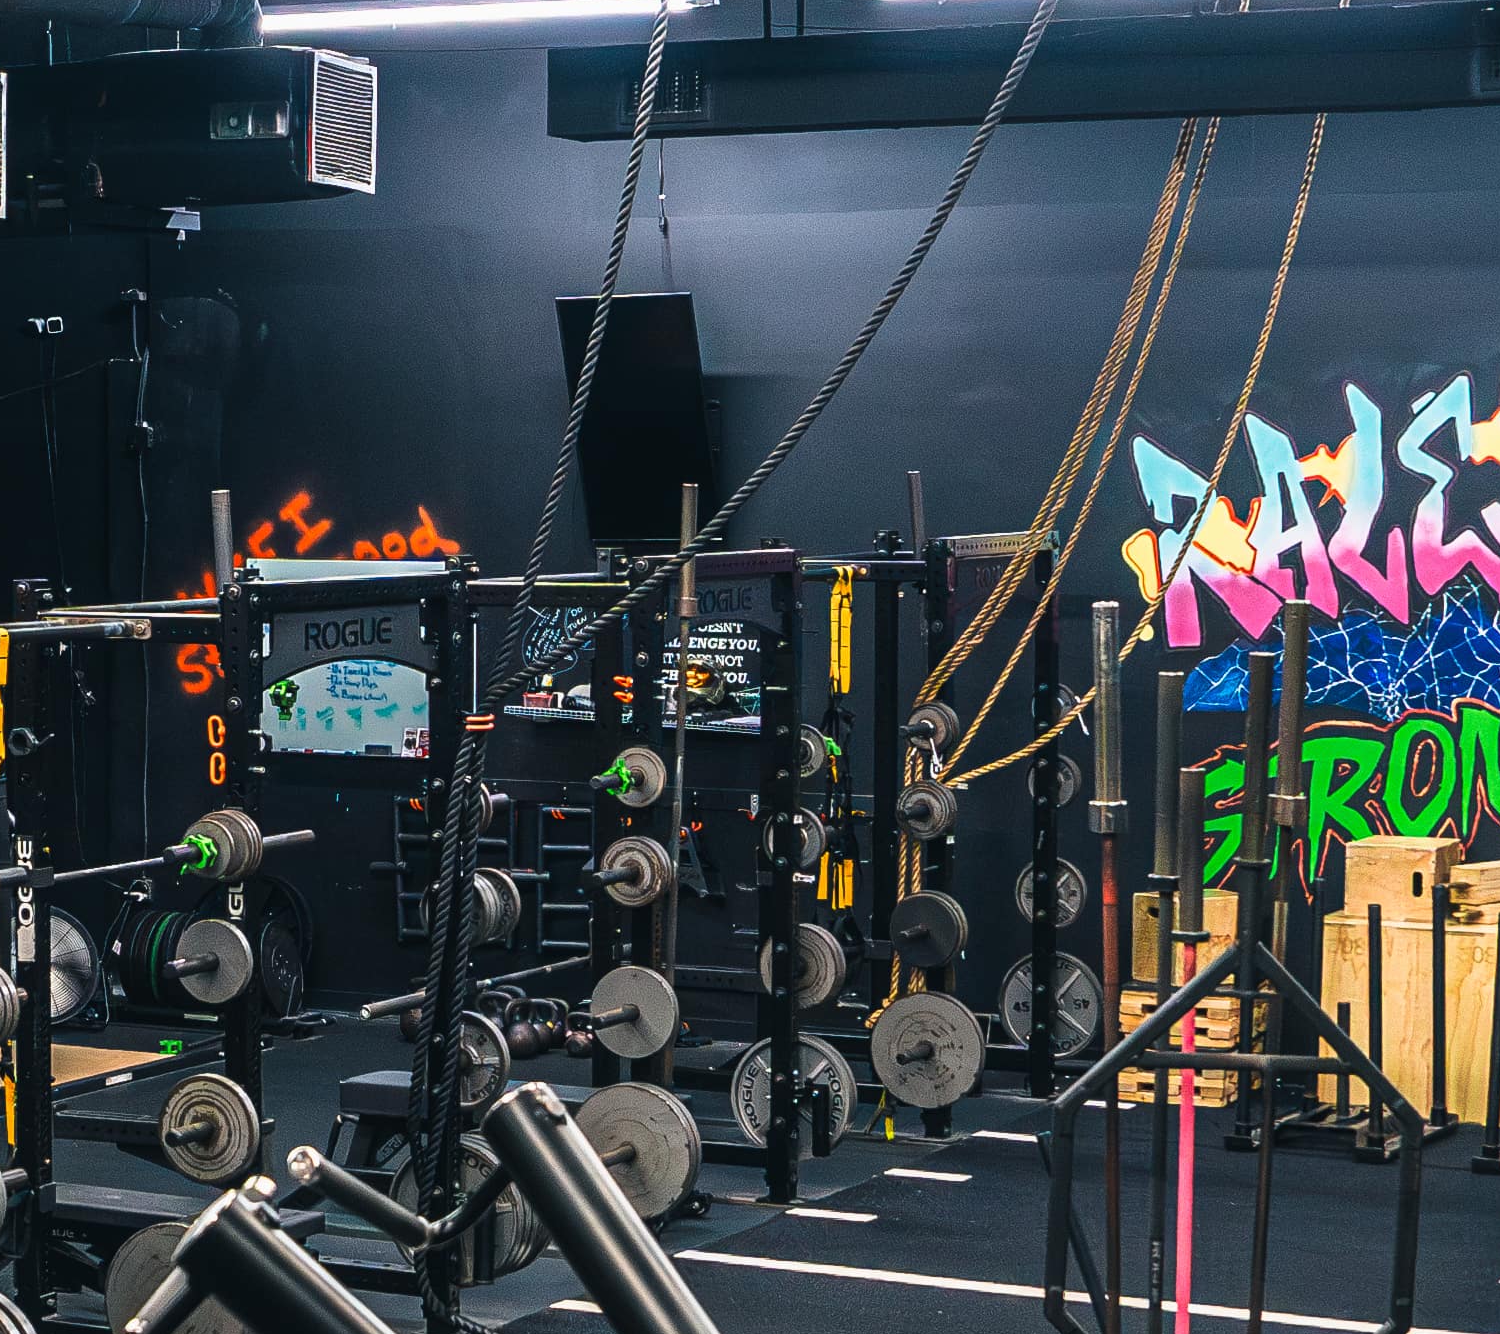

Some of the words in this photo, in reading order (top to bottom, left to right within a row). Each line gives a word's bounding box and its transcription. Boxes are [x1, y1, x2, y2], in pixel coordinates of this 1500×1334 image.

[304, 618, 393, 652] ROGUE
[714, 654, 744, 667] NOT
[743, 1063, 761, 1131] ROGUE
